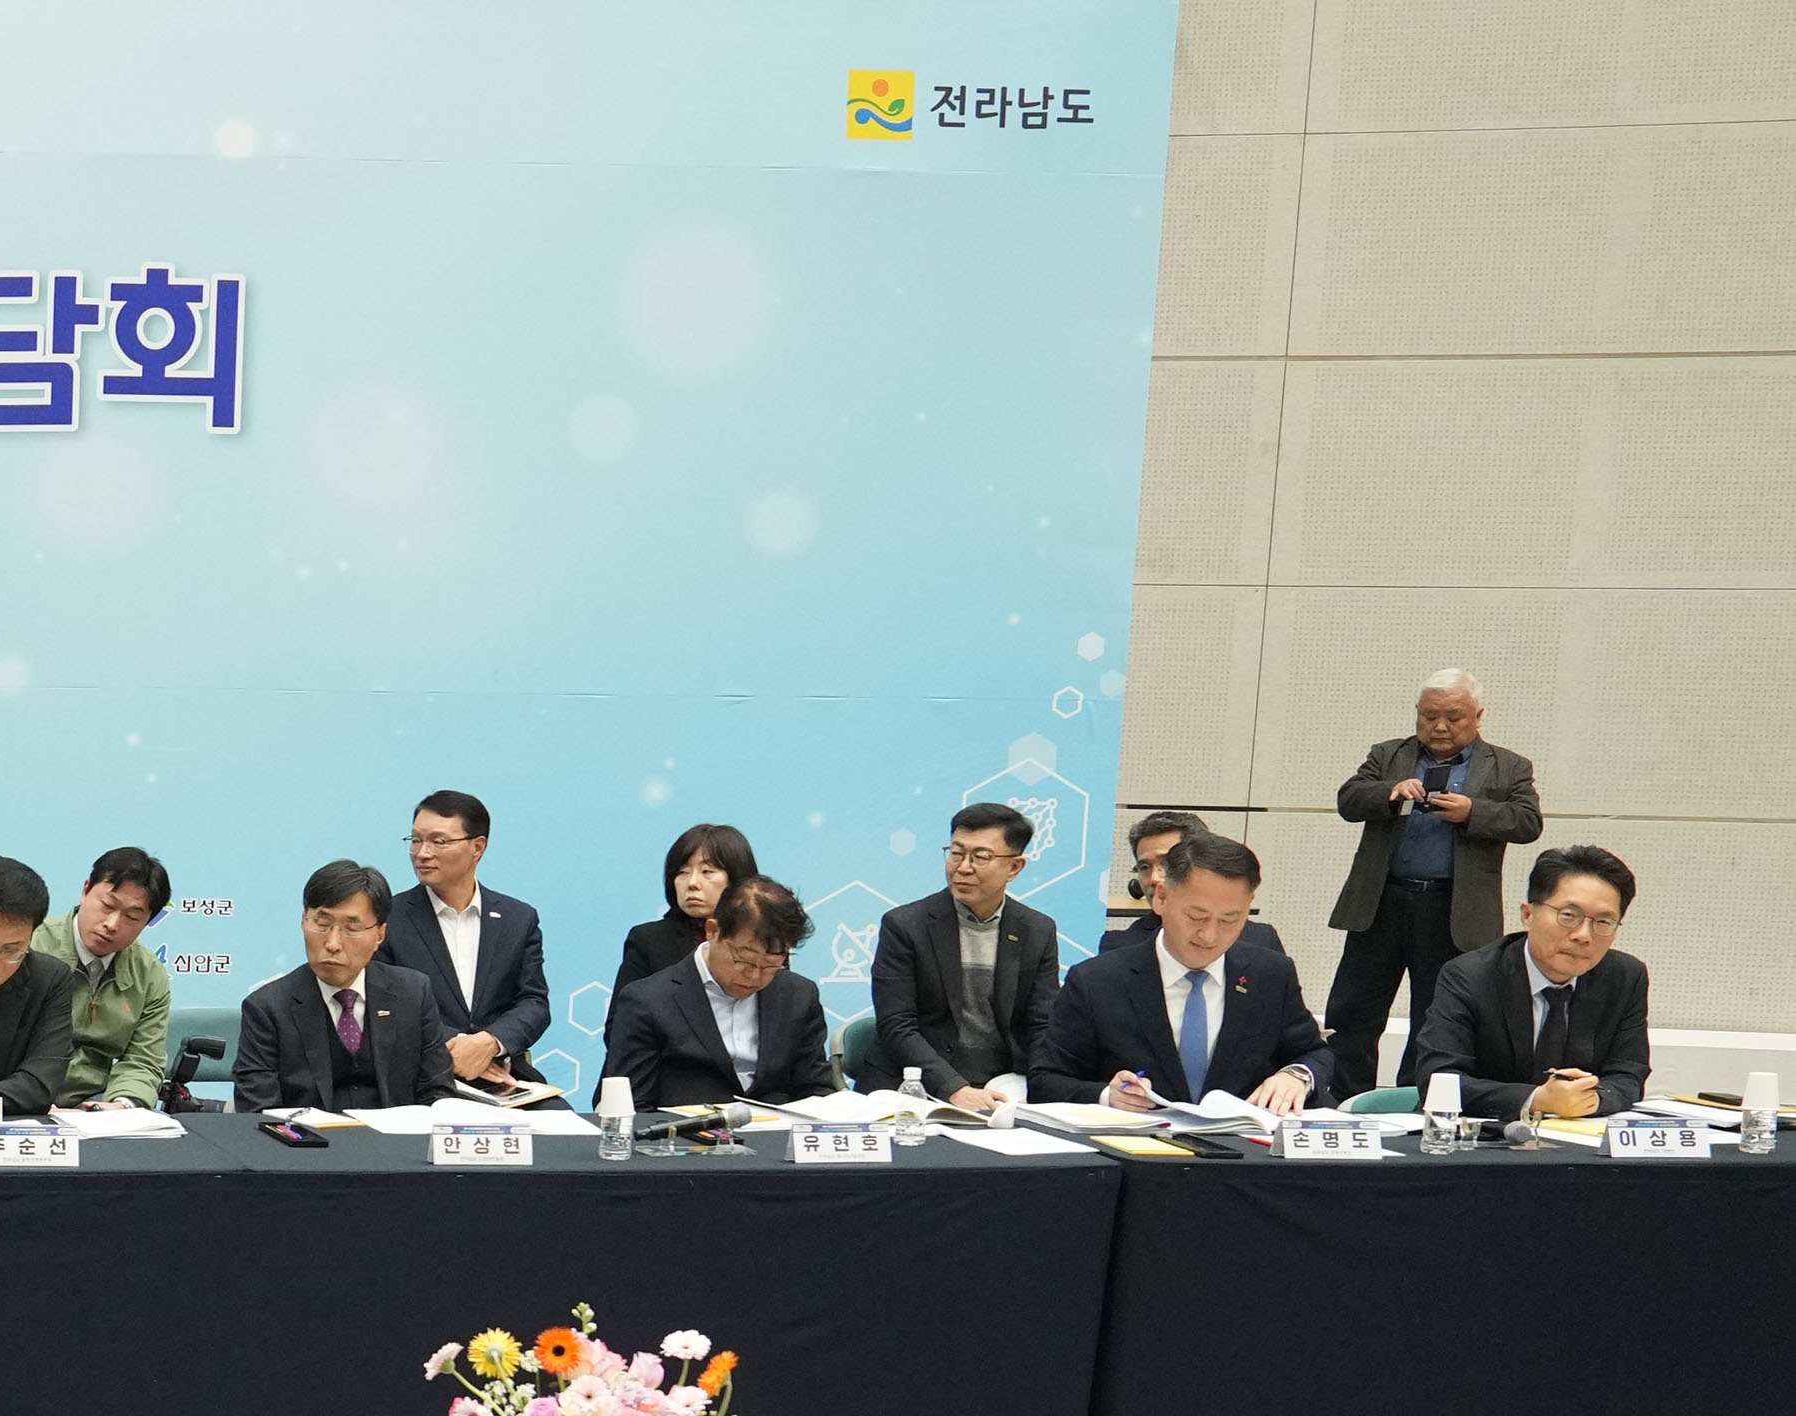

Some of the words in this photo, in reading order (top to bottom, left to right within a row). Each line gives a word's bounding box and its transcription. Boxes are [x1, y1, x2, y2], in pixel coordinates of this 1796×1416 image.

[930, 84, 1095, 130] 전라남도
[181, 900, 233, 916] 보성군
[174, 955, 231, 974] 신안군
